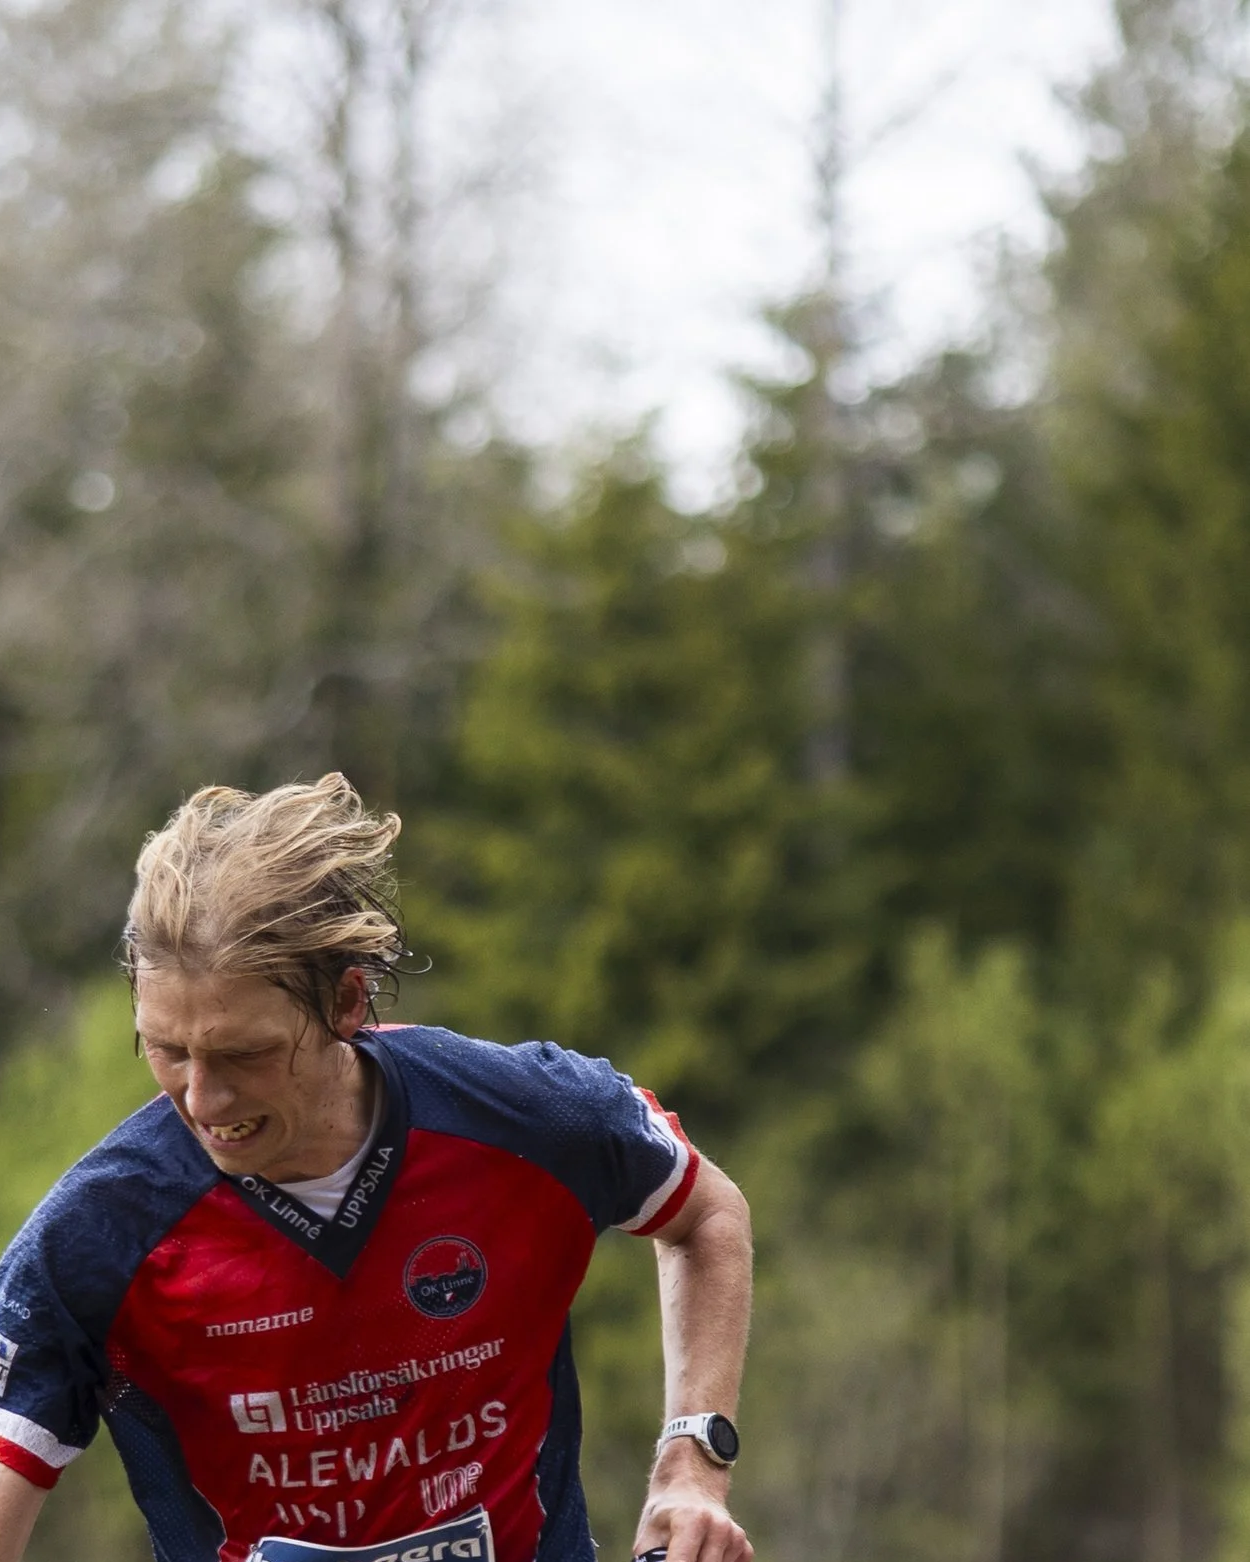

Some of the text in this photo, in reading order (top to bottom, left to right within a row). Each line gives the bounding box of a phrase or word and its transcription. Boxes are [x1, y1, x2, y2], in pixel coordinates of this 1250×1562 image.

[241, 1176, 324, 1240] OK Linné
[338, 1146, 394, 1229] UPPSALA
[205, 1305, 314, 1338] noname
[289, 1337, 506, 1408] Länsförsäkringar
[249, 1400, 508, 1488] ALEWALDS
[293, 1394, 399, 1436] Uppsala
